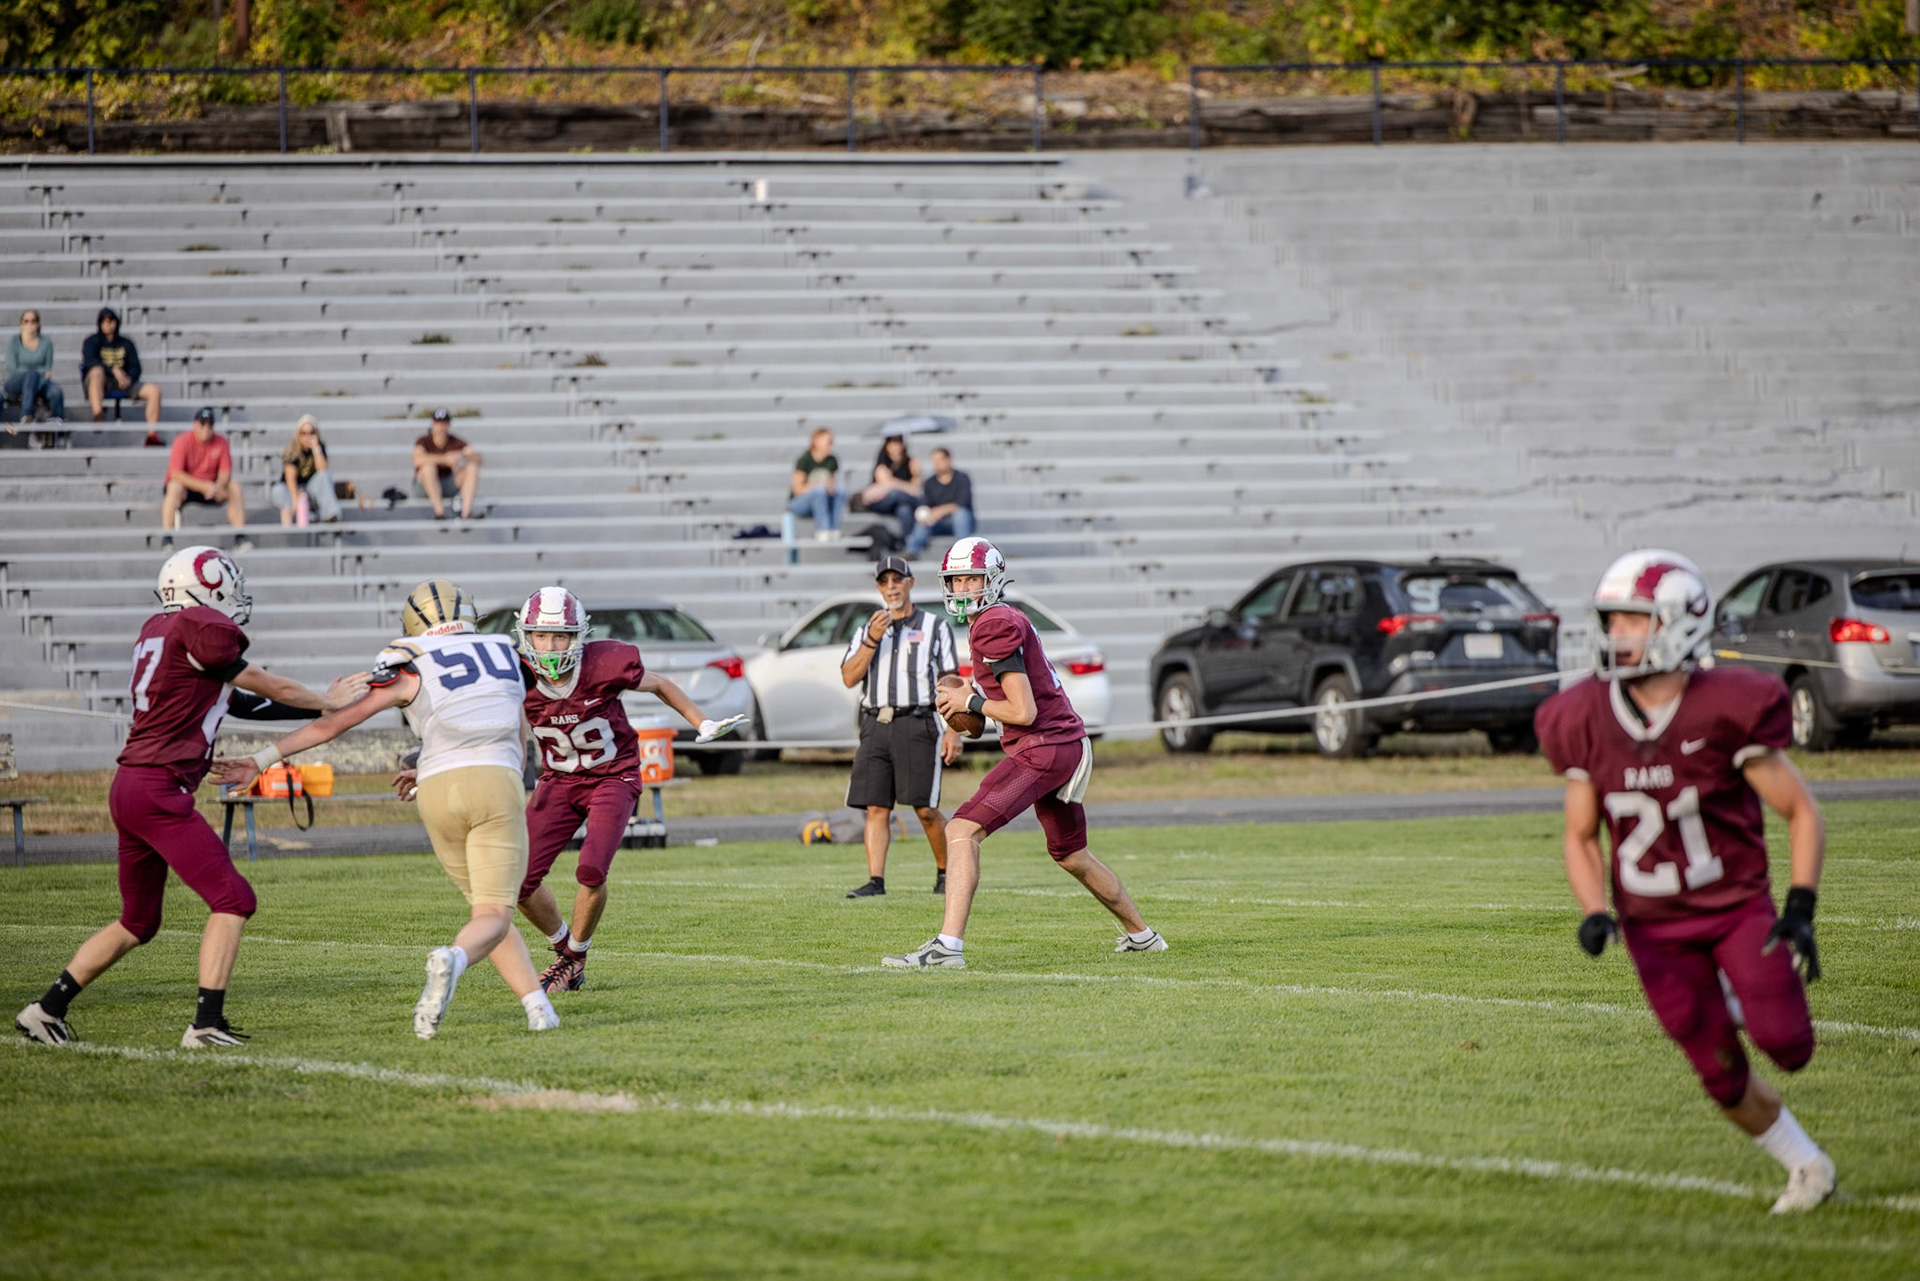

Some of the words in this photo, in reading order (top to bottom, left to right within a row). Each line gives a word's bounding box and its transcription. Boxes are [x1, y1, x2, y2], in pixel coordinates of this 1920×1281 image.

[430, 642, 519, 690] 50
[533, 716, 618, 773] 39
[550, 714, 580, 725] RAMS
[1604, 786, 1725, 895] 21
